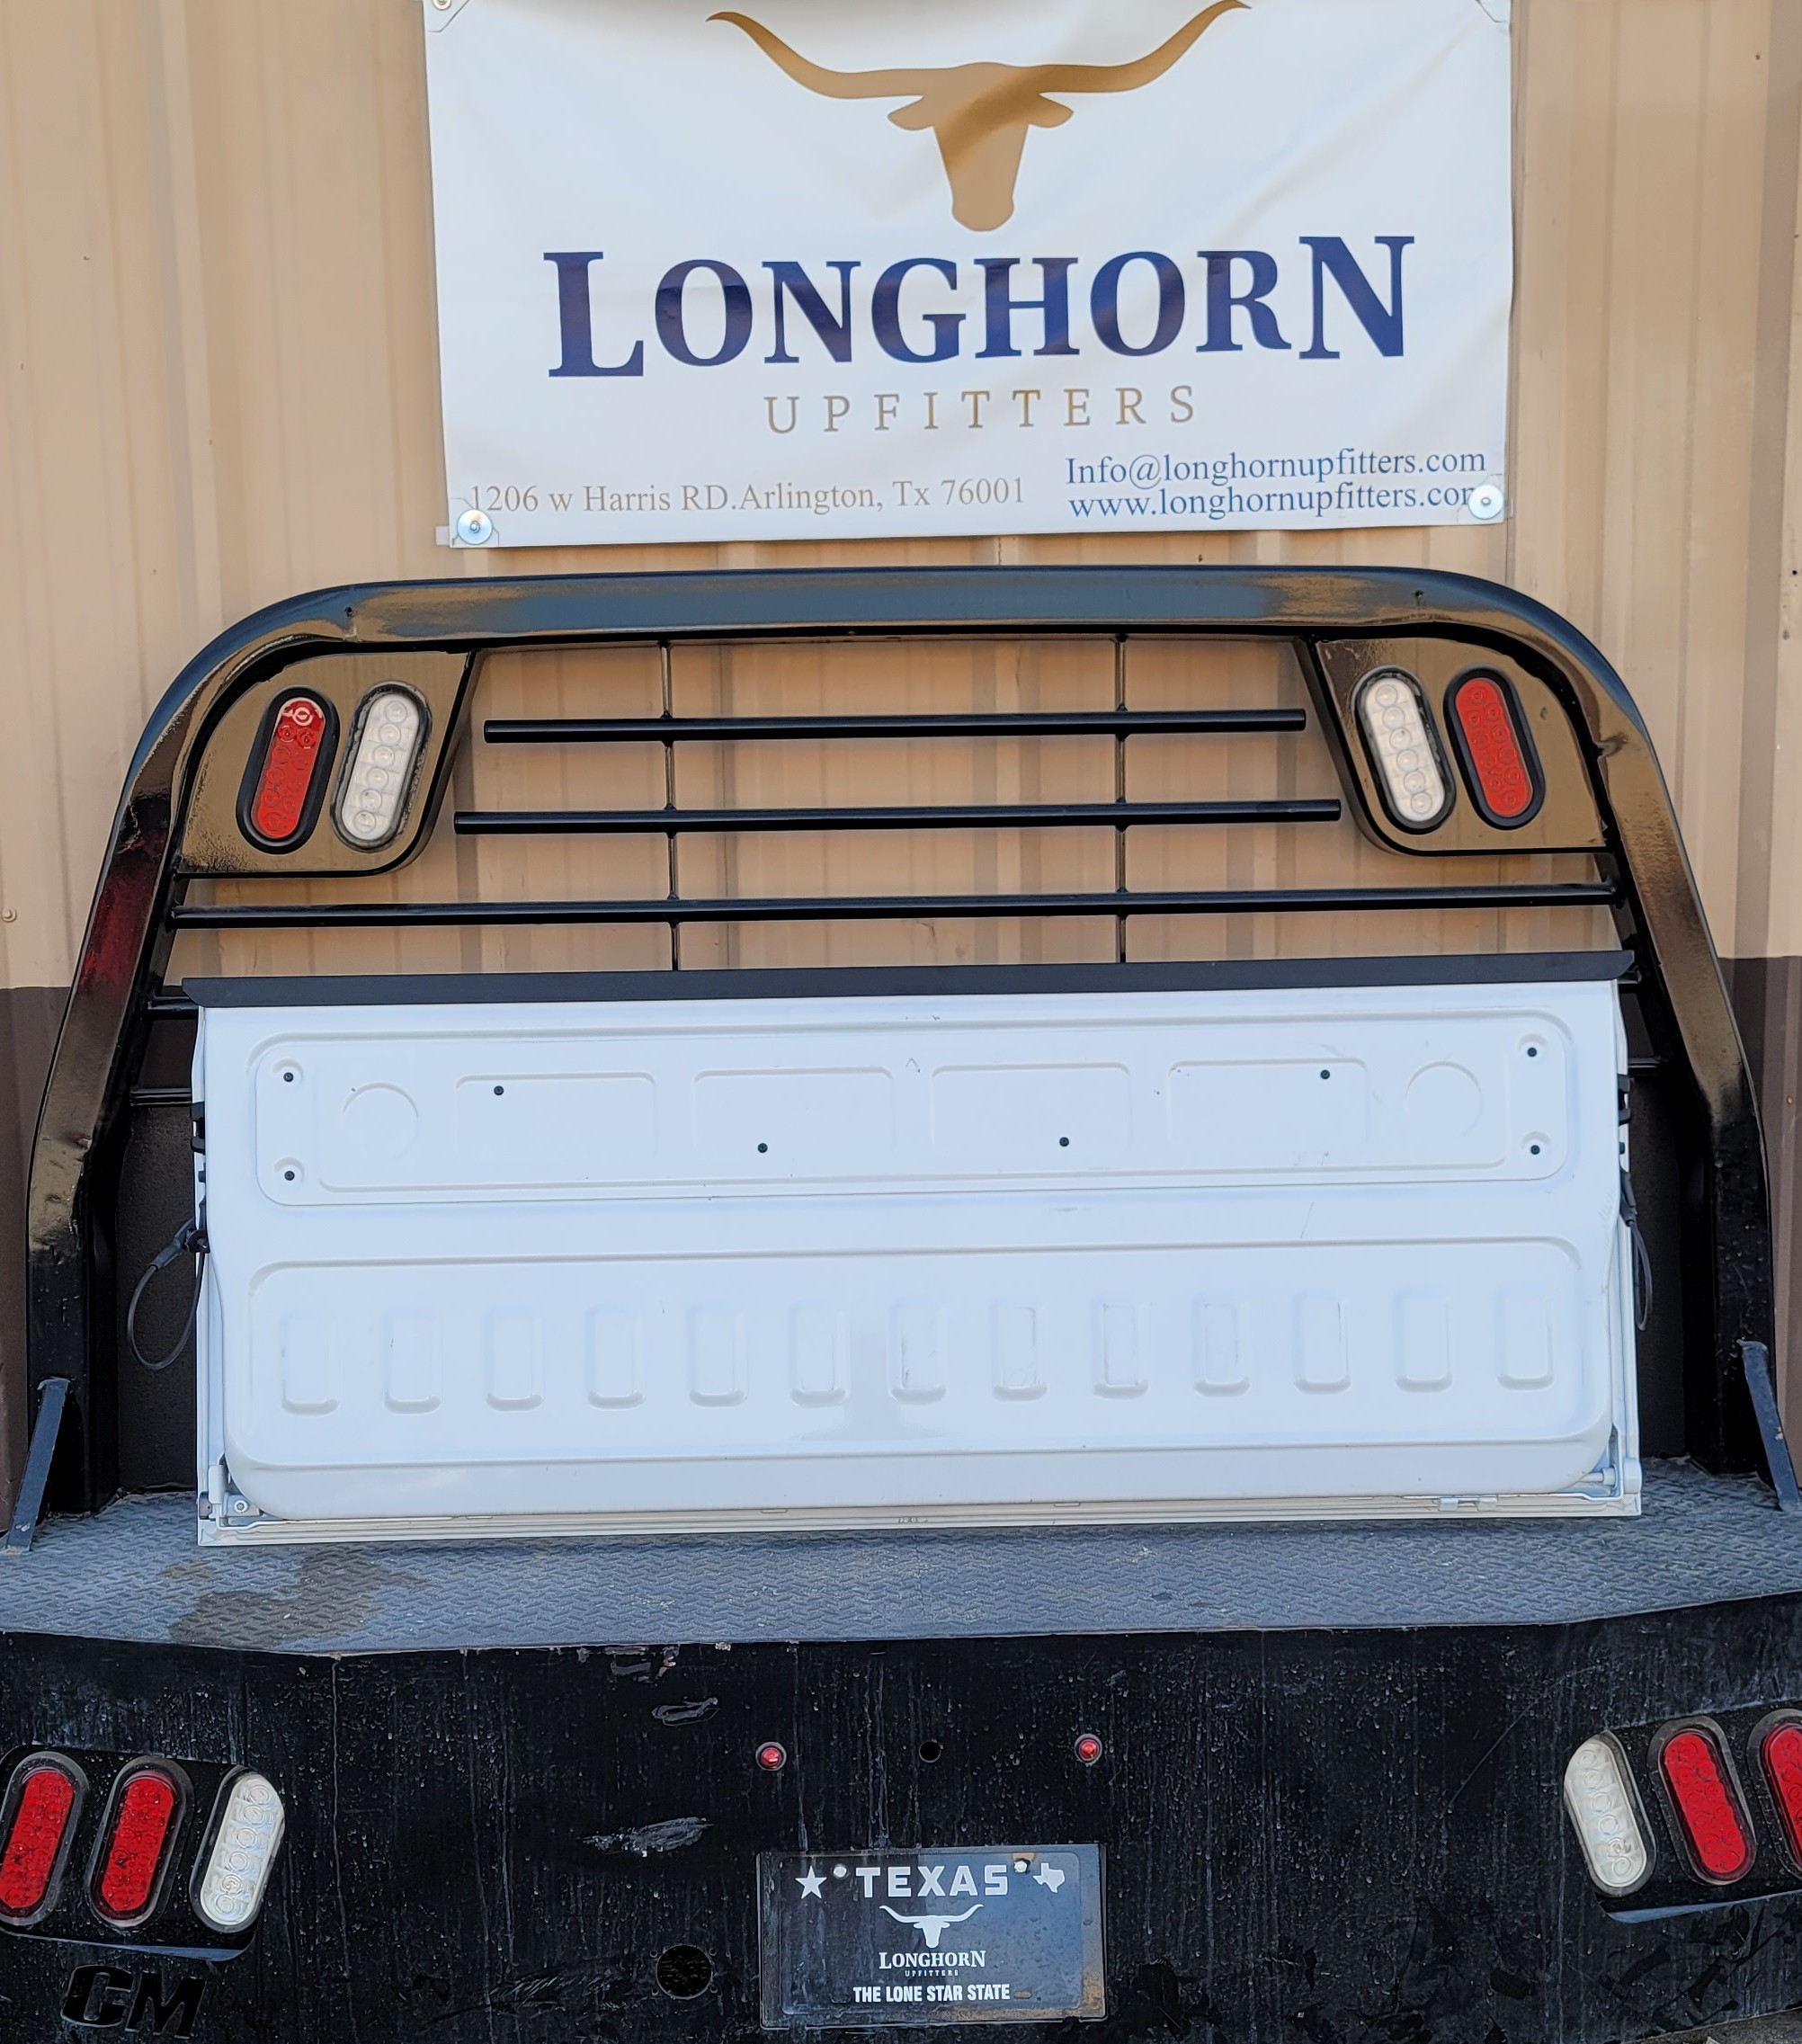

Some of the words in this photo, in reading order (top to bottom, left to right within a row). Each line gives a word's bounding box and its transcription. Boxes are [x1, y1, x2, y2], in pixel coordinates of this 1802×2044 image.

[542, 236, 1415, 378] LONGHORN
[763, 385, 1195, 434] UPFITTERS
[1065, 447, 1486, 490] Info@longhornupfitters.com
[470, 484, 540, 513] 1206
[548, 492, 574, 512] w
[582, 484, 672, 513] Harris
[891, 479, 932, 507] Tx
[941, 476, 1025, 506] 76001
[855, 1864, 1009, 1899] TEXAS
[878, 1950, 986, 1969] LONGHORN
[904, 1969, 959, 1977] UPFITTERS
[852, 1986, 881, 2004] THE
[885, 1985, 923, 2003] LONE
[926, 1984, 963, 2002] STAR
[967, 1983, 1011, 2001] STATE
